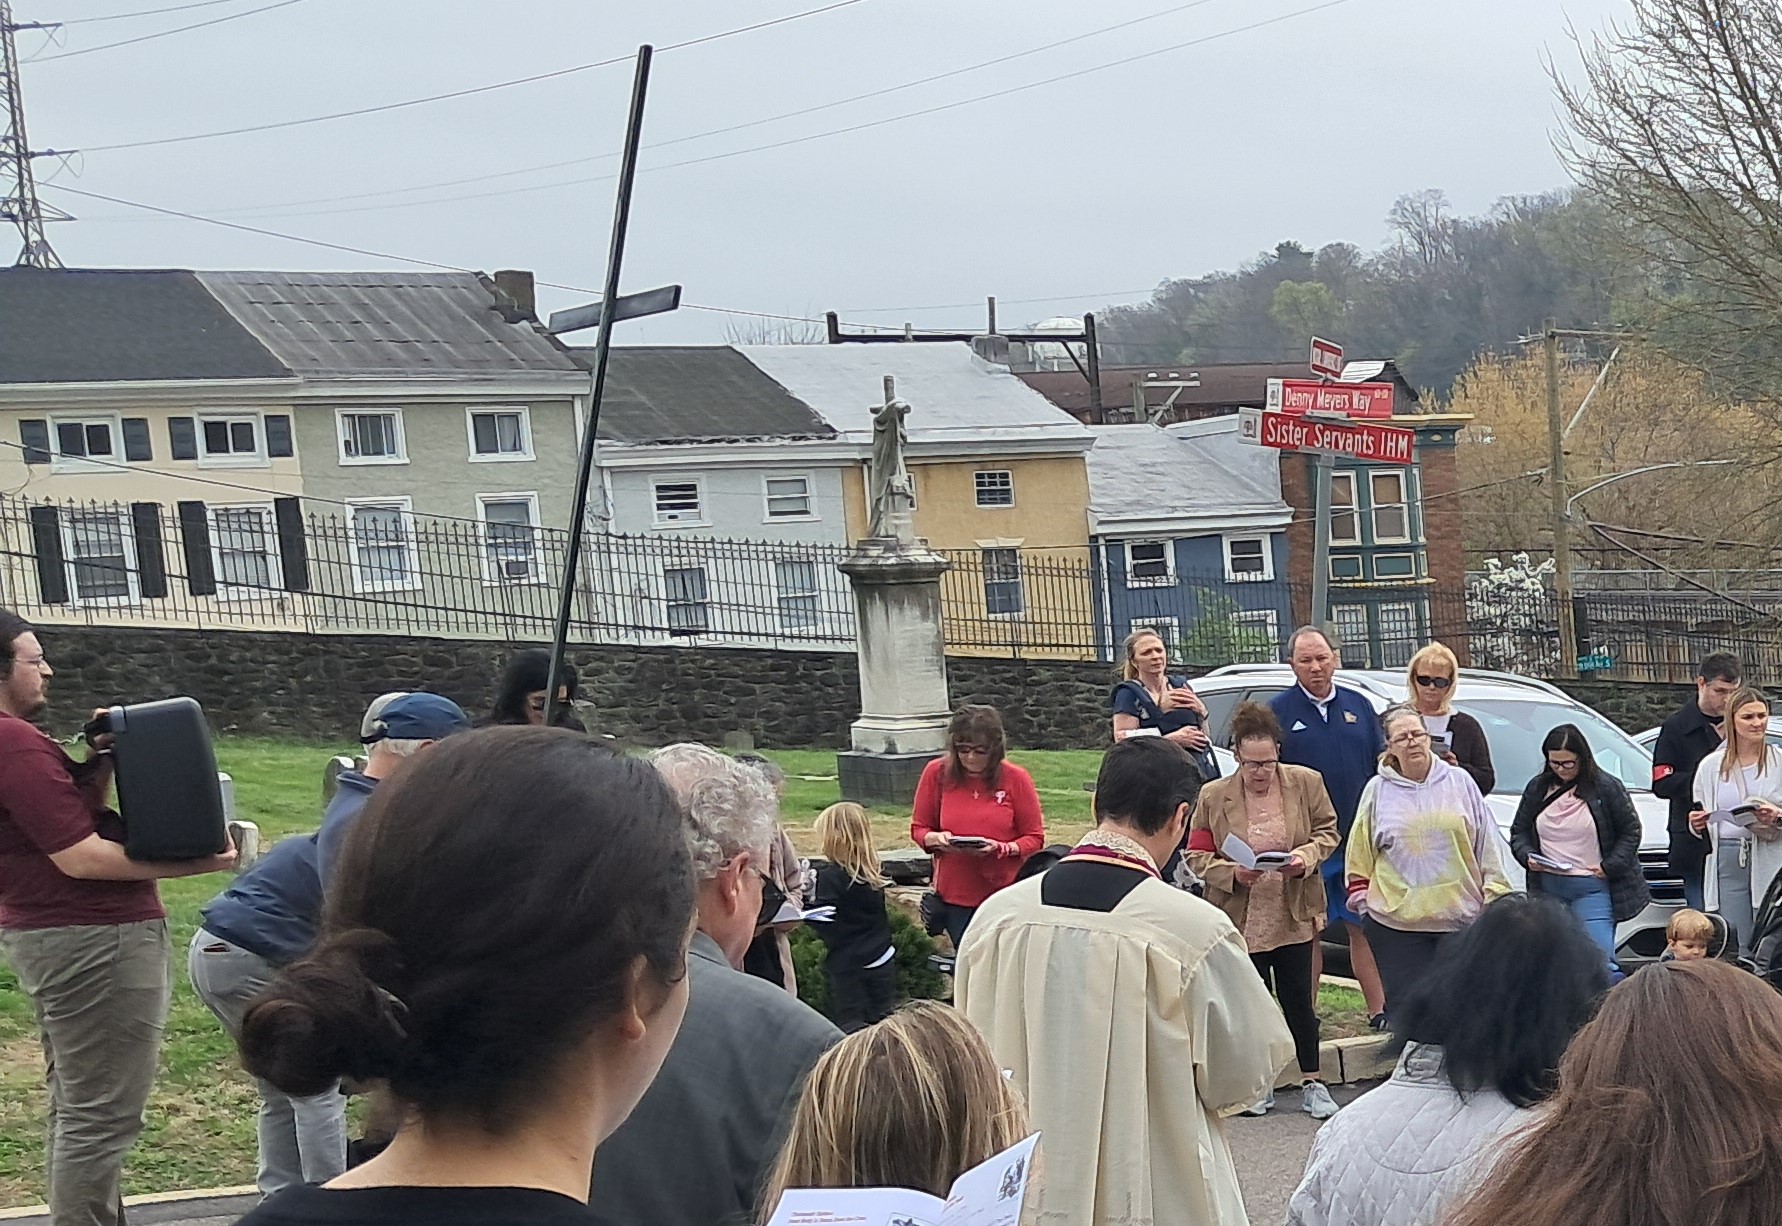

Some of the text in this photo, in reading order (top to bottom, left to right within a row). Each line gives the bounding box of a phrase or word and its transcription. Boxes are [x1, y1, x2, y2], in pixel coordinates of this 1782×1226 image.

[1285, 387, 1314, 410] Denny
[1317, 389, 1349, 411] Meyers
[1352, 390, 1371, 413] Way
[1267, 417, 1409, 458] Sister Servants IHM
